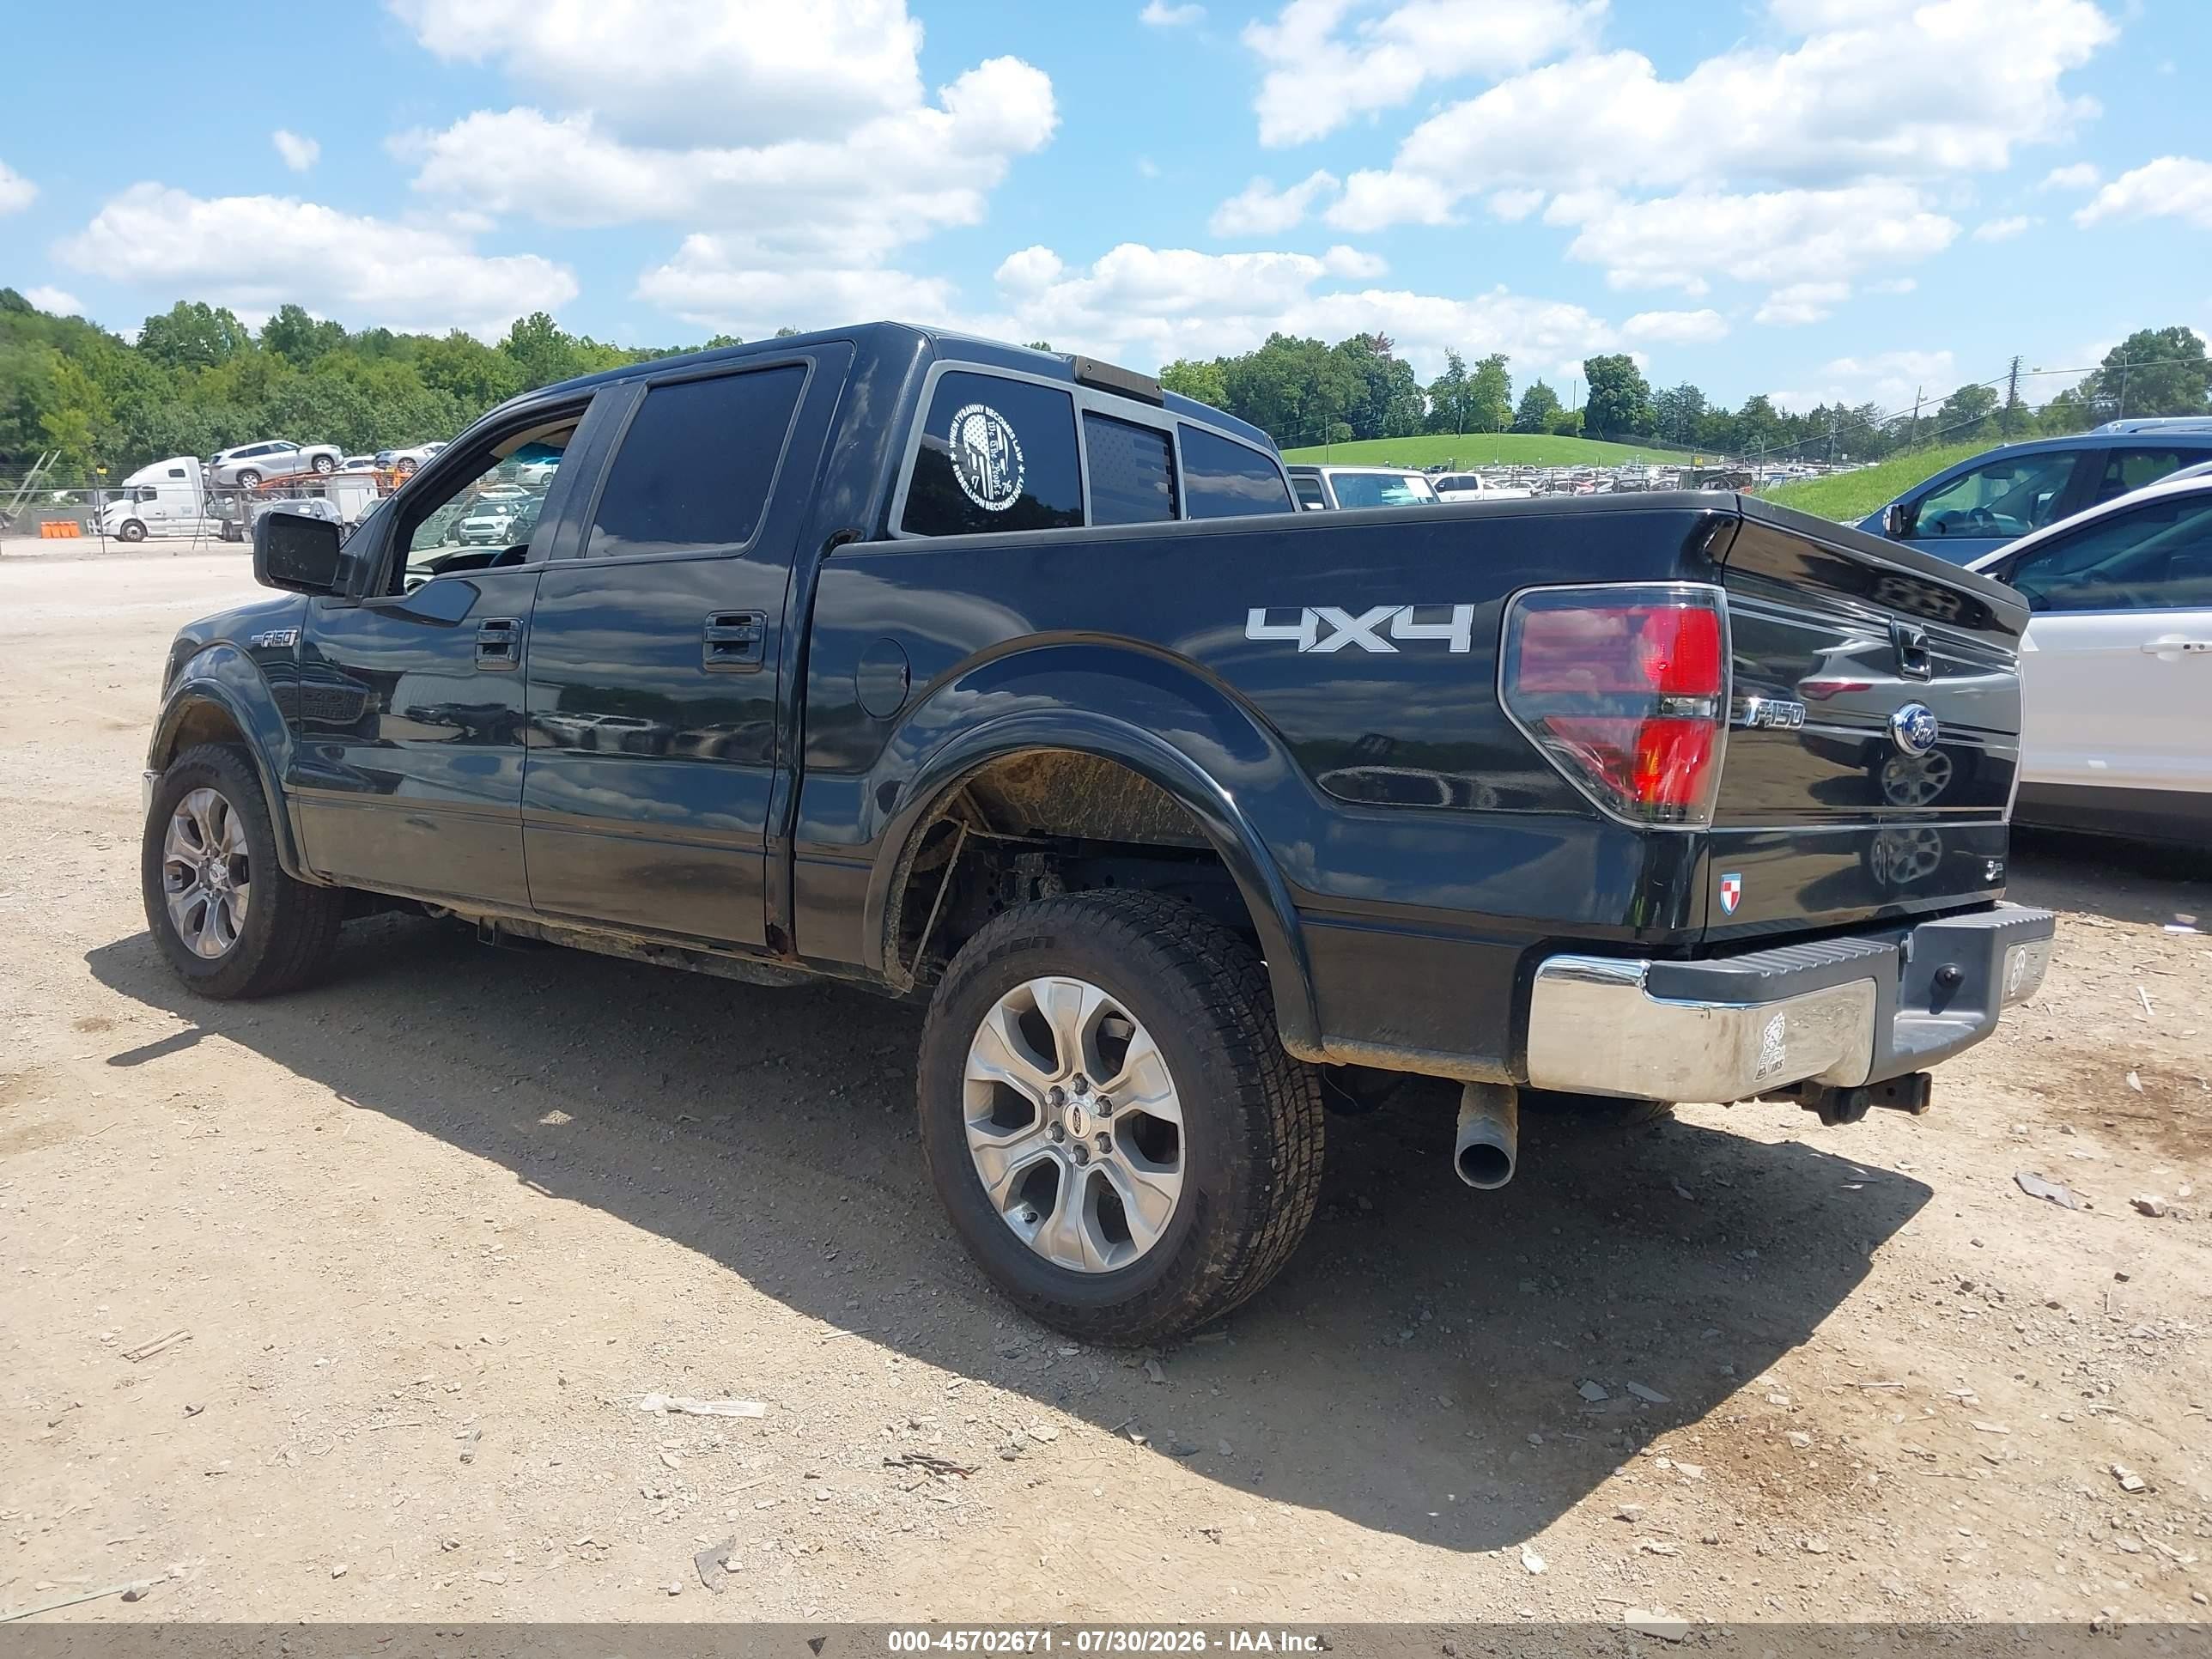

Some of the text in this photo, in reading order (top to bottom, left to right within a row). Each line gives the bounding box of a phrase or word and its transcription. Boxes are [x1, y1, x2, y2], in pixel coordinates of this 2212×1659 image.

[949, 404, 1024, 463] WHEN TYRANNY BECOMES LAW
[952, 464, 1025, 512] REBELLION BECOMES DUTY
[1245, 605, 1475, 653] 4X4
